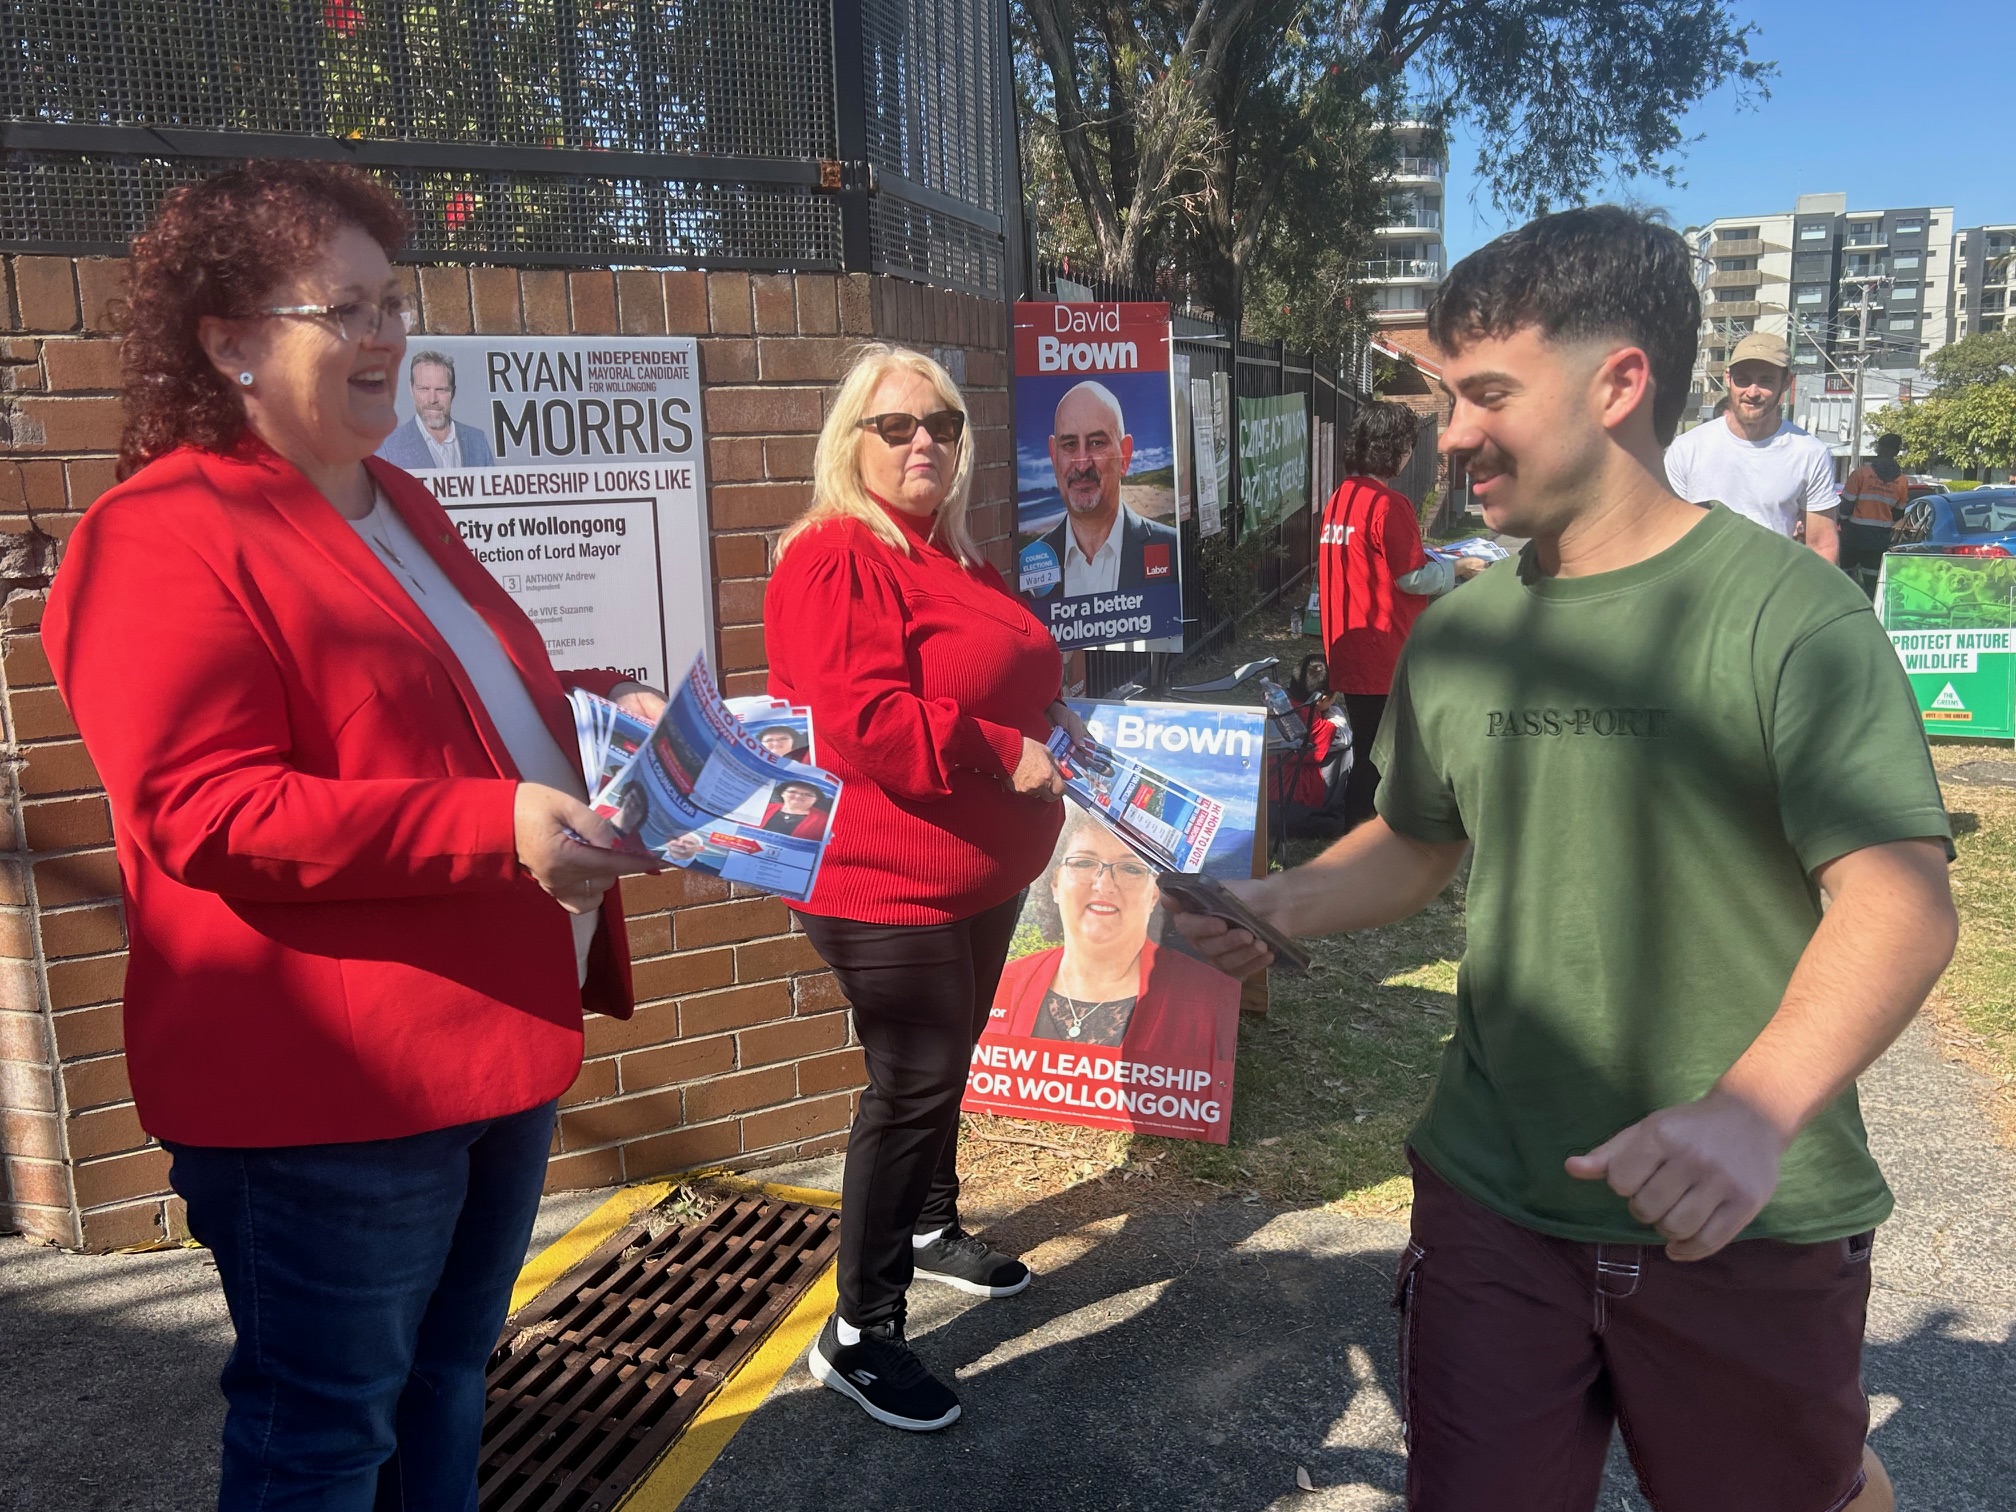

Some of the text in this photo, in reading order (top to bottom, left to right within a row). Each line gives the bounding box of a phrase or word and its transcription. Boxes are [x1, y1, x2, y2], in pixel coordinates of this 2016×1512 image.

[1054, 303, 1120, 333] David
[587, 351, 688, 365] INDEPENDENT
[1038, 336, 1138, 371] Brown
[486, 351, 584, 393] RYAN
[588, 366, 690, 380] MAYORAL CANDIDATE
[589, 382, 657, 393] FOR WOLLONGONG
[491, 397, 693, 458] MORRIS
[433, 475, 475, 498] NEW
[481, 472, 588, 496] LEADERSHIP
[594, 471, 650, 491] LOOKS
[655, 469, 692, 489] LIKE
[456, 516, 626, 543] City of Wollongong
[527, 545, 541, 560] of
[544, 543, 576, 559] Lord
[579, 542, 621, 559] Mayor
[1025, 552, 1050, 563] COUNCIL
[1022, 560, 1053, 572] ELECTIONS
[1146, 566, 1168, 576] Labor
[508, 572, 596, 590] 3 ANTHONY Andrew
[526, 583, 560, 592] Independent
[1026, 573, 1052, 586] Ward 2
[528, 605, 594, 617] de VIVE Suzanne
[1051, 594, 1143, 620] For a better
[532, 616, 563, 624] dependent
[1046, 614, 1151, 641] Wollongong
[544, 637, 595, 649] TTAKER Jess
[1892, 633, 2009, 651] PROTECT NATURE
[1905, 653, 1968, 669] WILDLIFE
[717, 704, 734, 727] TO
[736, 725, 779, 764] VOTE
[1116, 714, 1251, 757] Brown
[1130, 774, 1140, 784] FOR
[653, 762, 696, 817] COUNCILLOR
[1202, 814, 1219, 836] HOW
[1185, 825, 1200, 845] BROWN
[1197, 834, 1209, 847] TO
[1188, 845, 1204, 866] VOTE
[971, 1043, 1211, 1092] NEW LEADERSHIP
[1017, 1076, 1220, 1123] WOLLONGONG
